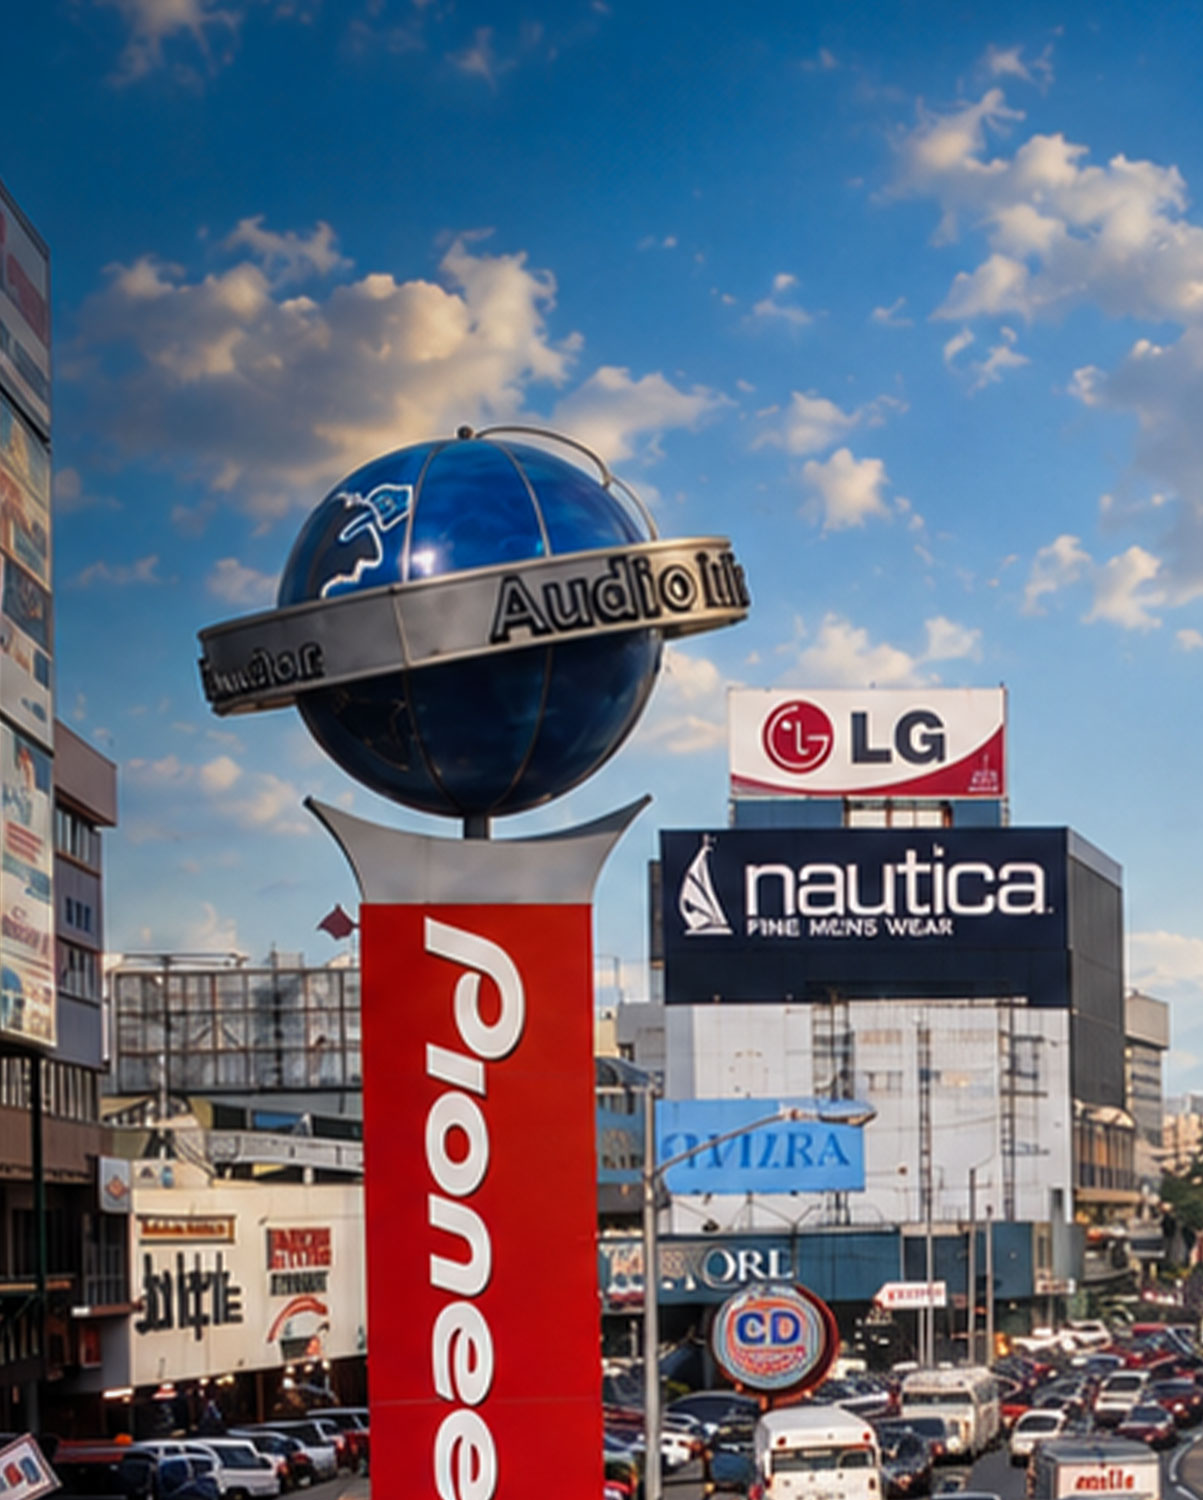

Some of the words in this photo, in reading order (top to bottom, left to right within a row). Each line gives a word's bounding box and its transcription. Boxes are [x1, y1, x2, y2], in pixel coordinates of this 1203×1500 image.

[850, 710, 946, 765] LG
[745, 843, 1045, 917] nautica
[885, 918, 954, 937] WEAR
[736, 1308, 801, 1345] CD
